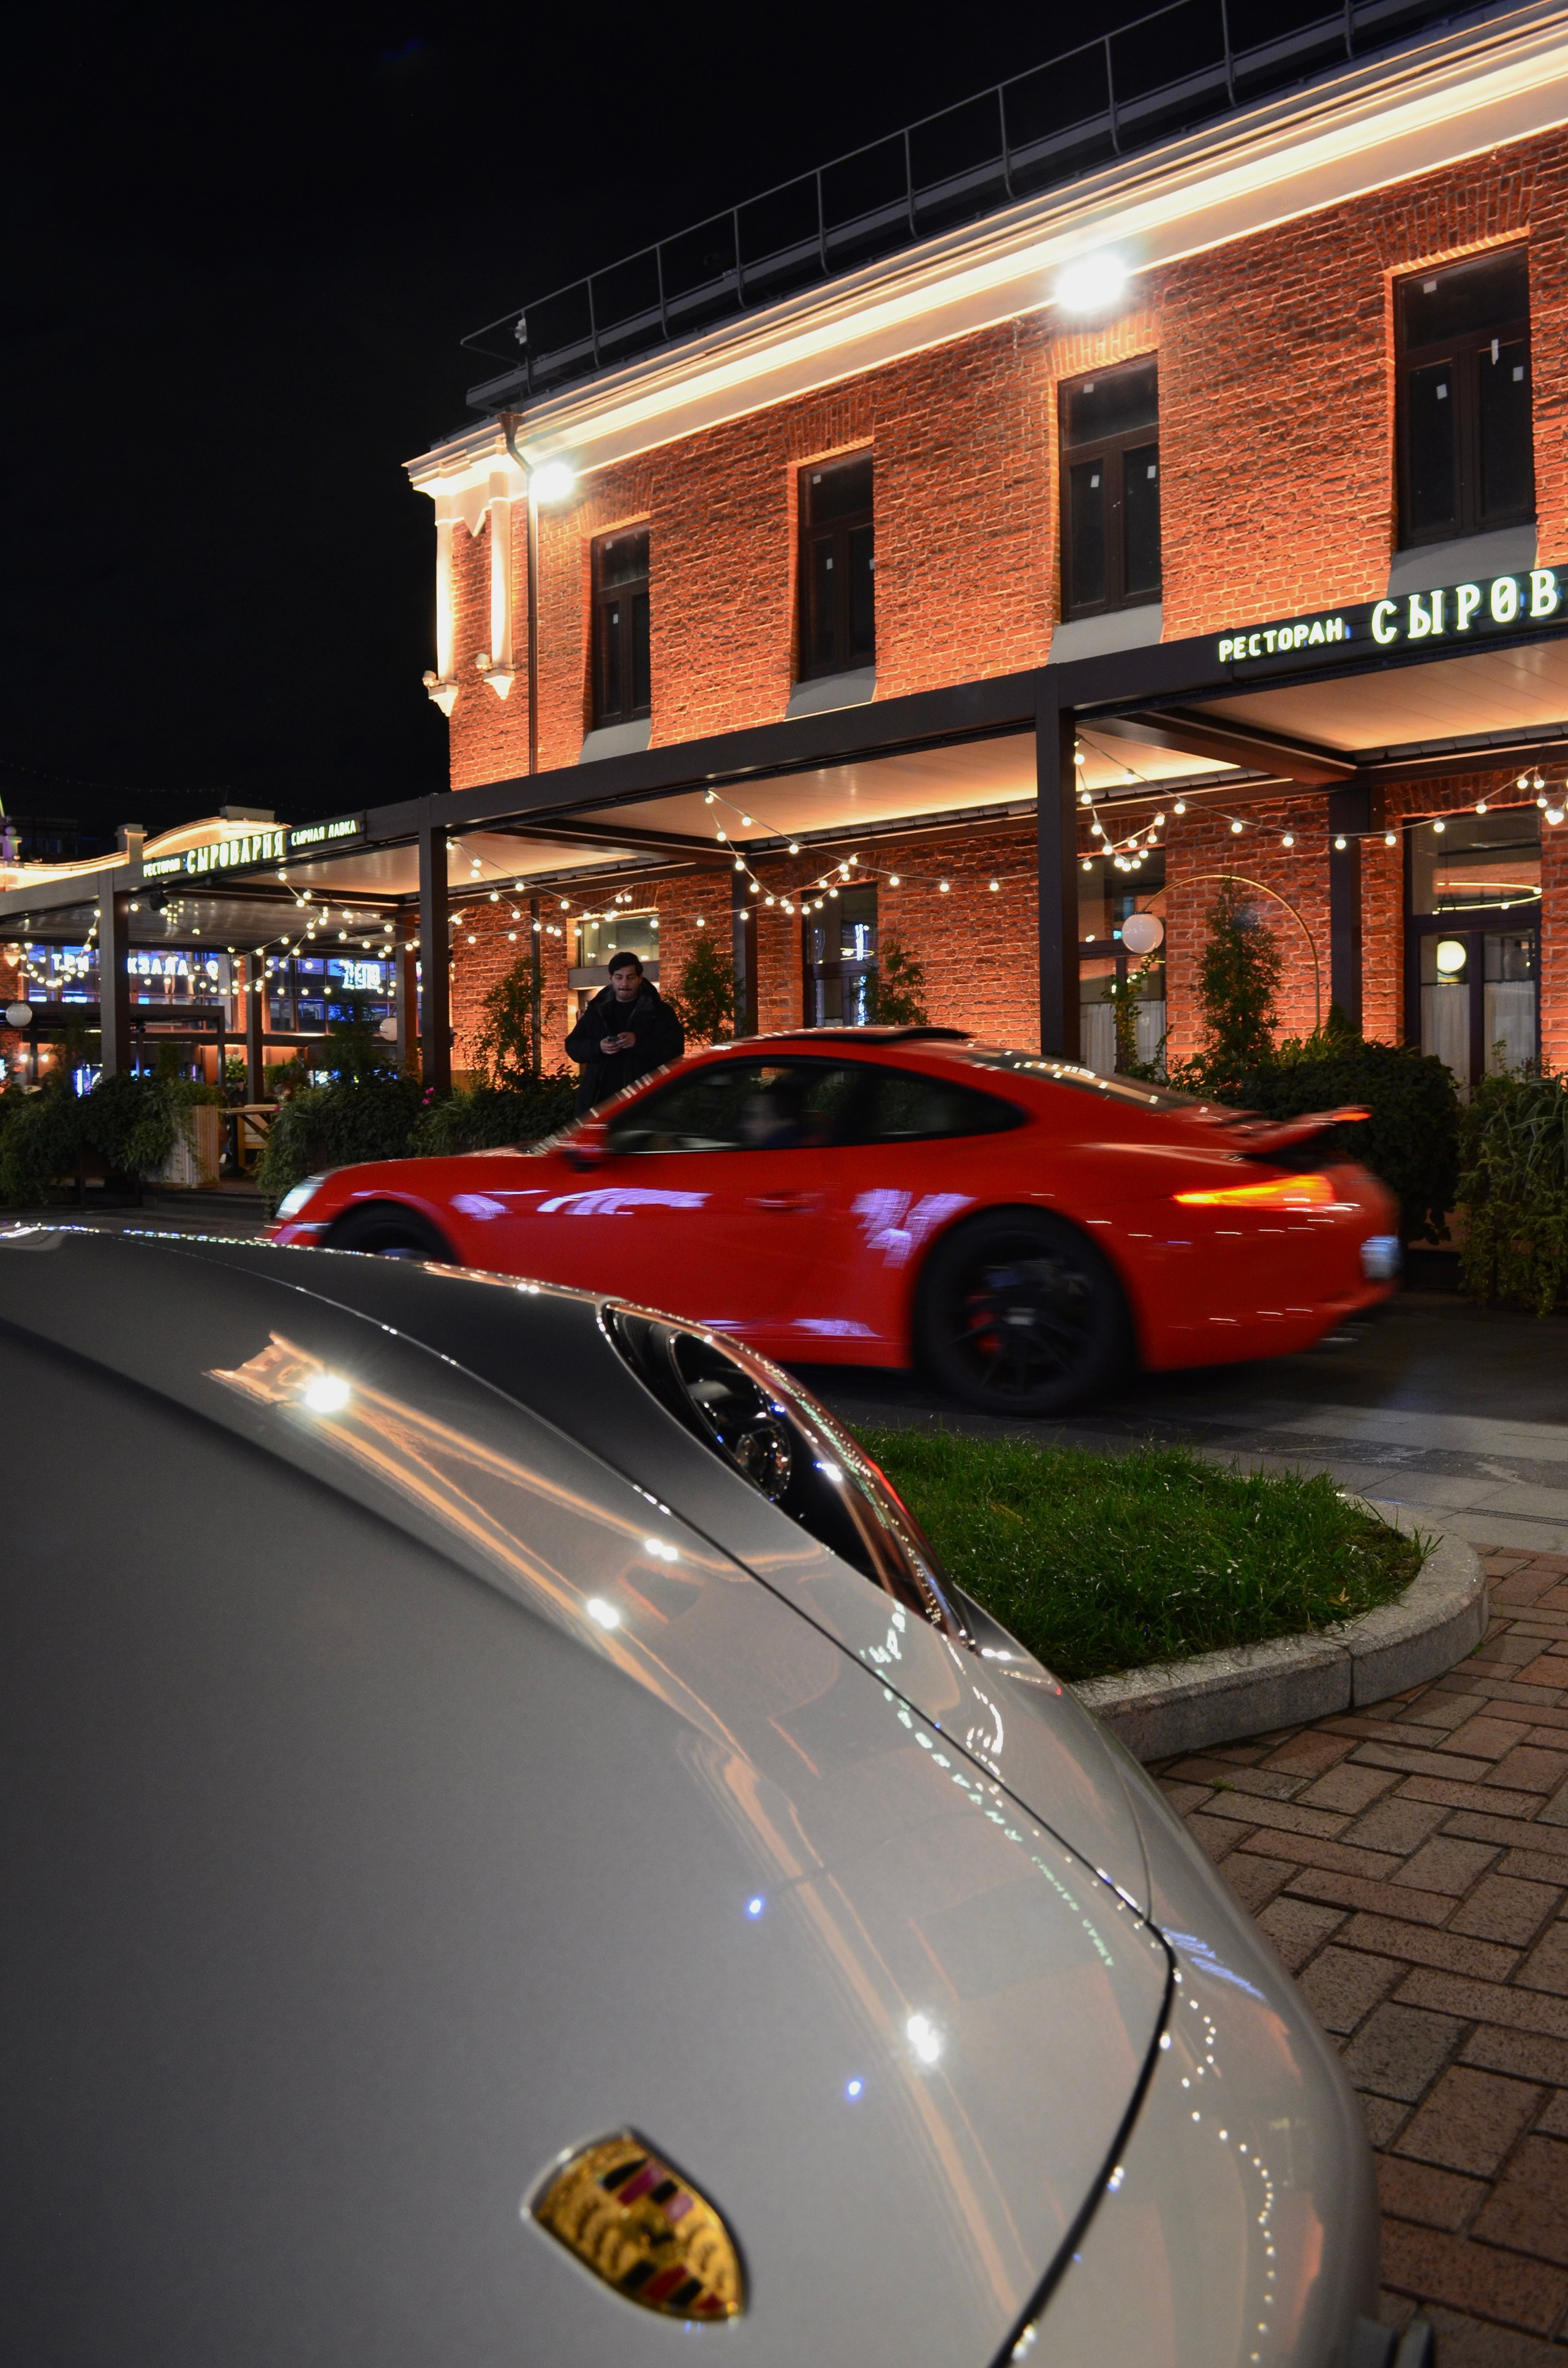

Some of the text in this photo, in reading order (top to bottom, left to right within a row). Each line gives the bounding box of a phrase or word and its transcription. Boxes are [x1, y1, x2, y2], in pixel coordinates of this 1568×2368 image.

[1219, 618, 1343, 662] РЕСТОРАН
[143, 820, 356, 877] РЕСТОРАН СЫРОВАРНЯ СЫРНАЯ ЛАВКА
[127, 956, 189, 976] КЗАЛА
